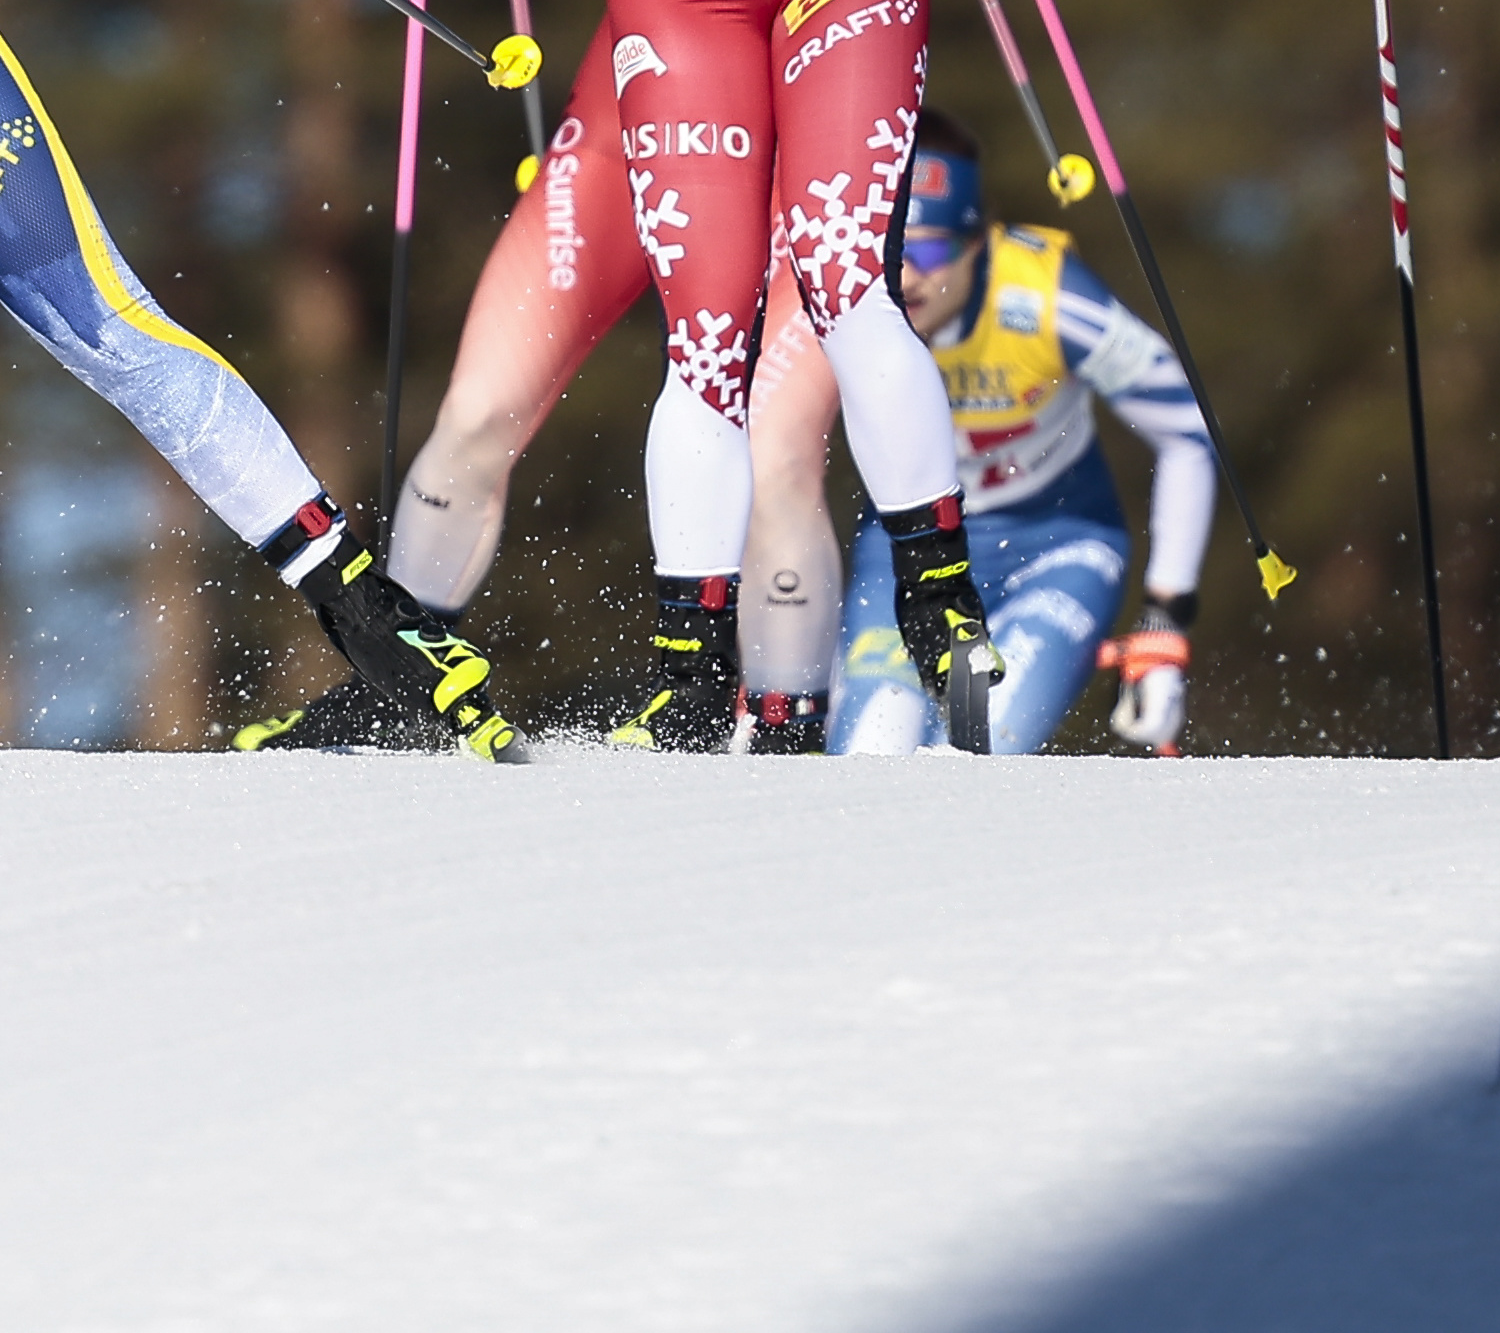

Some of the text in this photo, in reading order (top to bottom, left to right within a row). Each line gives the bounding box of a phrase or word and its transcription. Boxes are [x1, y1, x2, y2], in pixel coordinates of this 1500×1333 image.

[616, 39, 647, 72] Gilde
[784, 0, 893, 85] CRAFT
[547, 153, 586, 293] Sunrise
